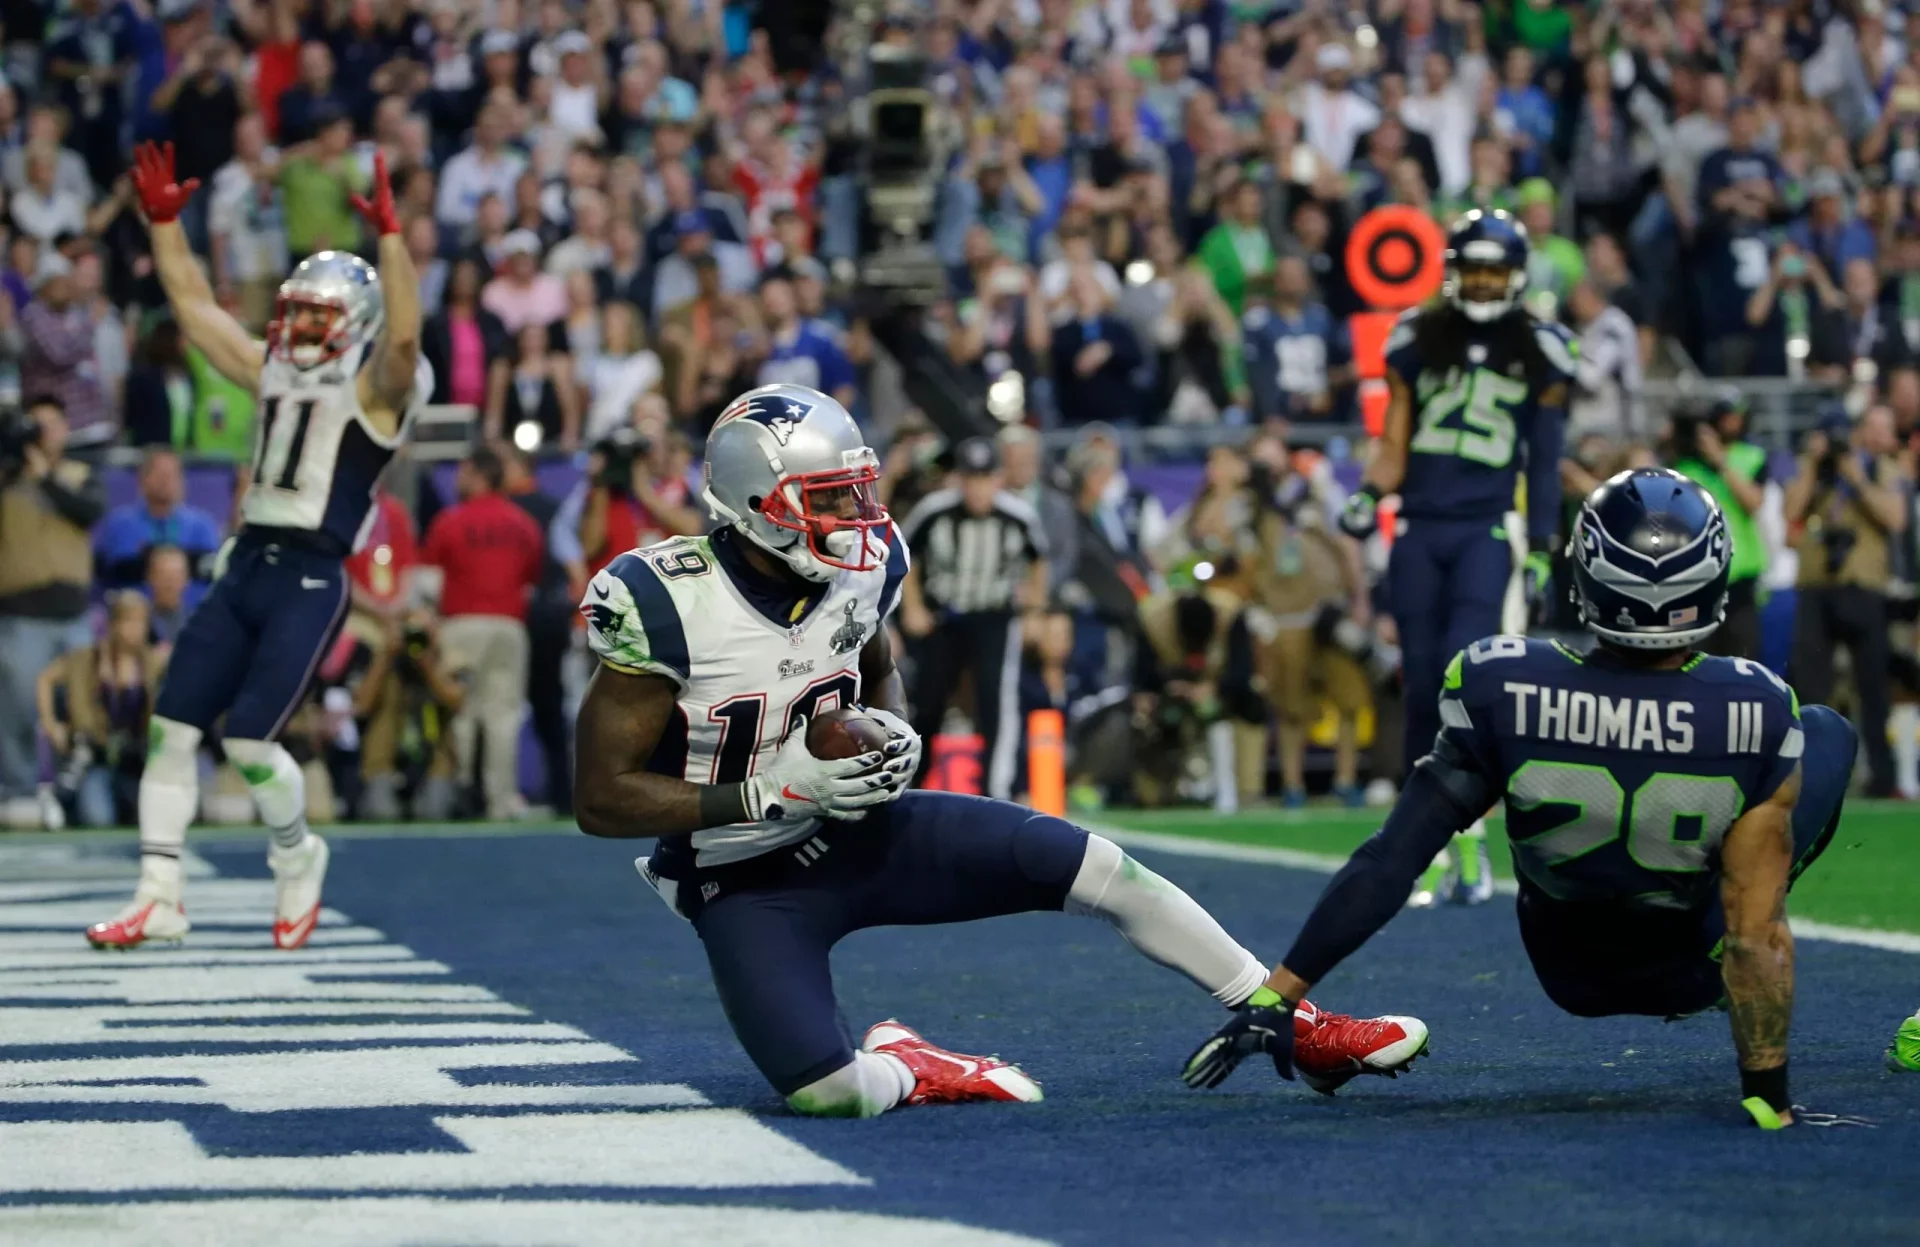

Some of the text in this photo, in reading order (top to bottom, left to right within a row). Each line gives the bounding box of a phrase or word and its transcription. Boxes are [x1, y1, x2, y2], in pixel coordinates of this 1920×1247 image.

[254, 394, 322, 492] 11
[1411, 365, 1529, 468] 25
[1504, 681, 1763, 753] THOMAS III
[1507, 759, 1746, 876] 29
